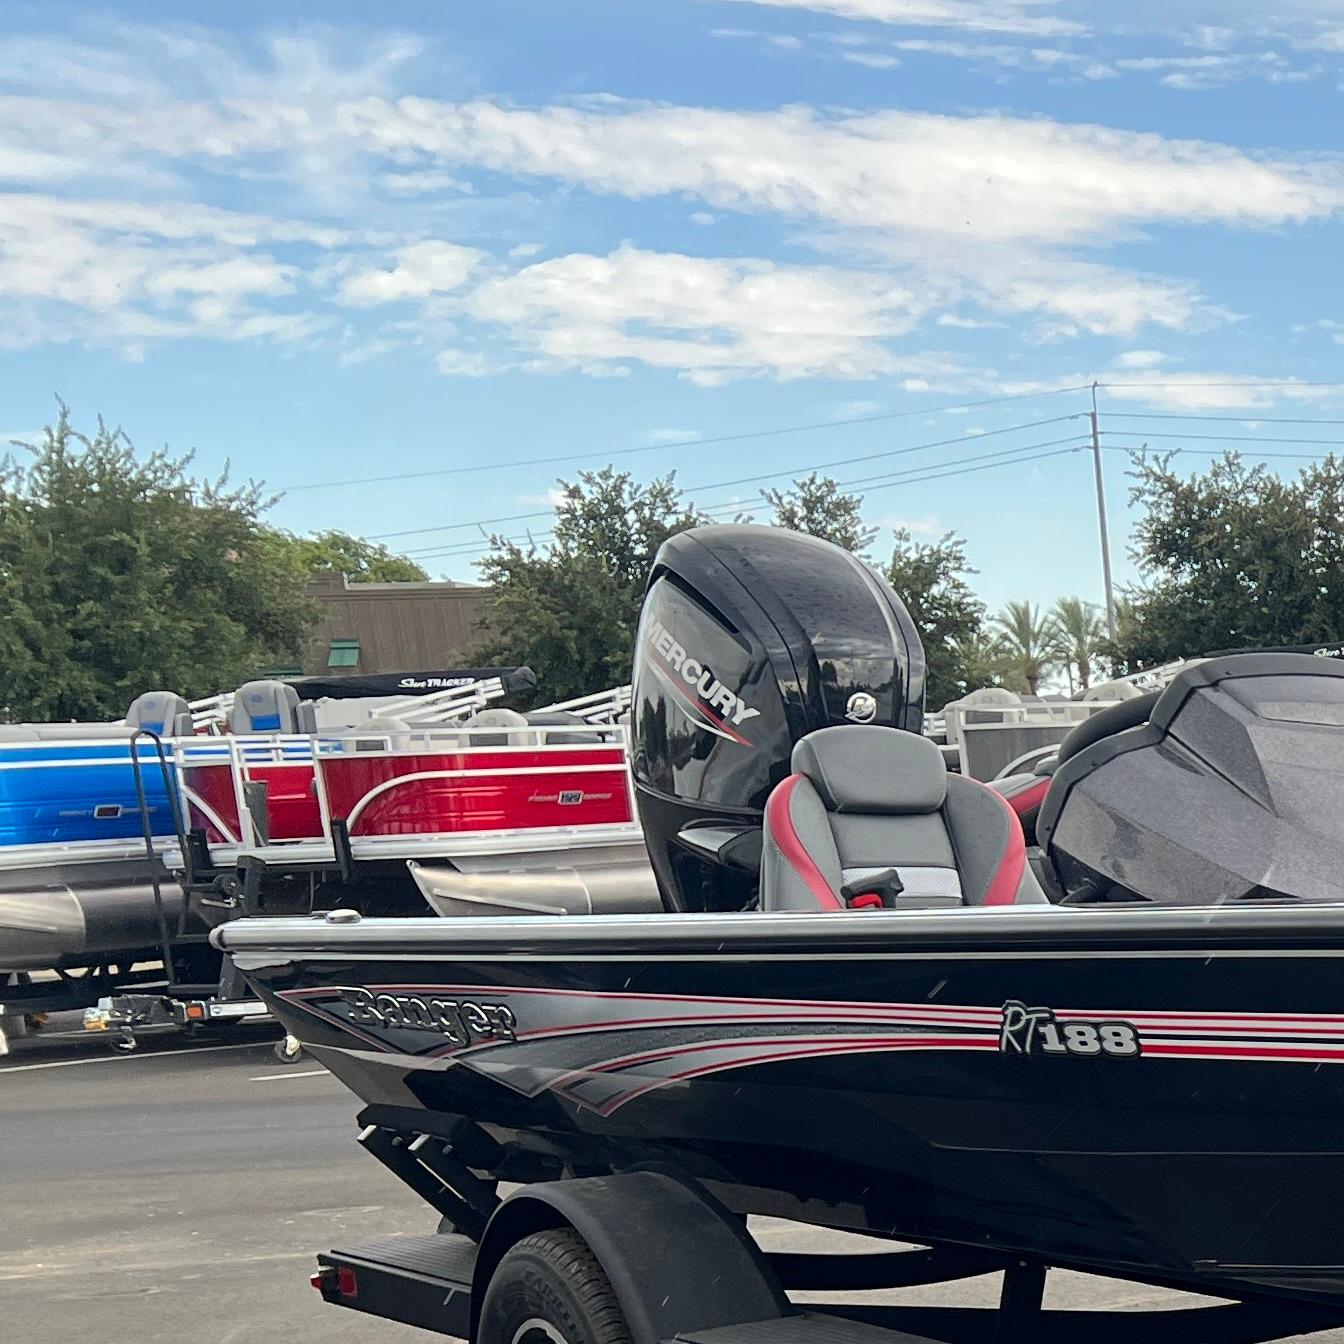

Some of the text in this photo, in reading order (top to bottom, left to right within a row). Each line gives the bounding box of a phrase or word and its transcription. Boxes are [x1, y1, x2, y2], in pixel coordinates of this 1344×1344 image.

[427, 677, 475, 688] TRACKER
[646, 621, 761, 726] MERCURY
[336, 985, 517, 1048] Ranger
